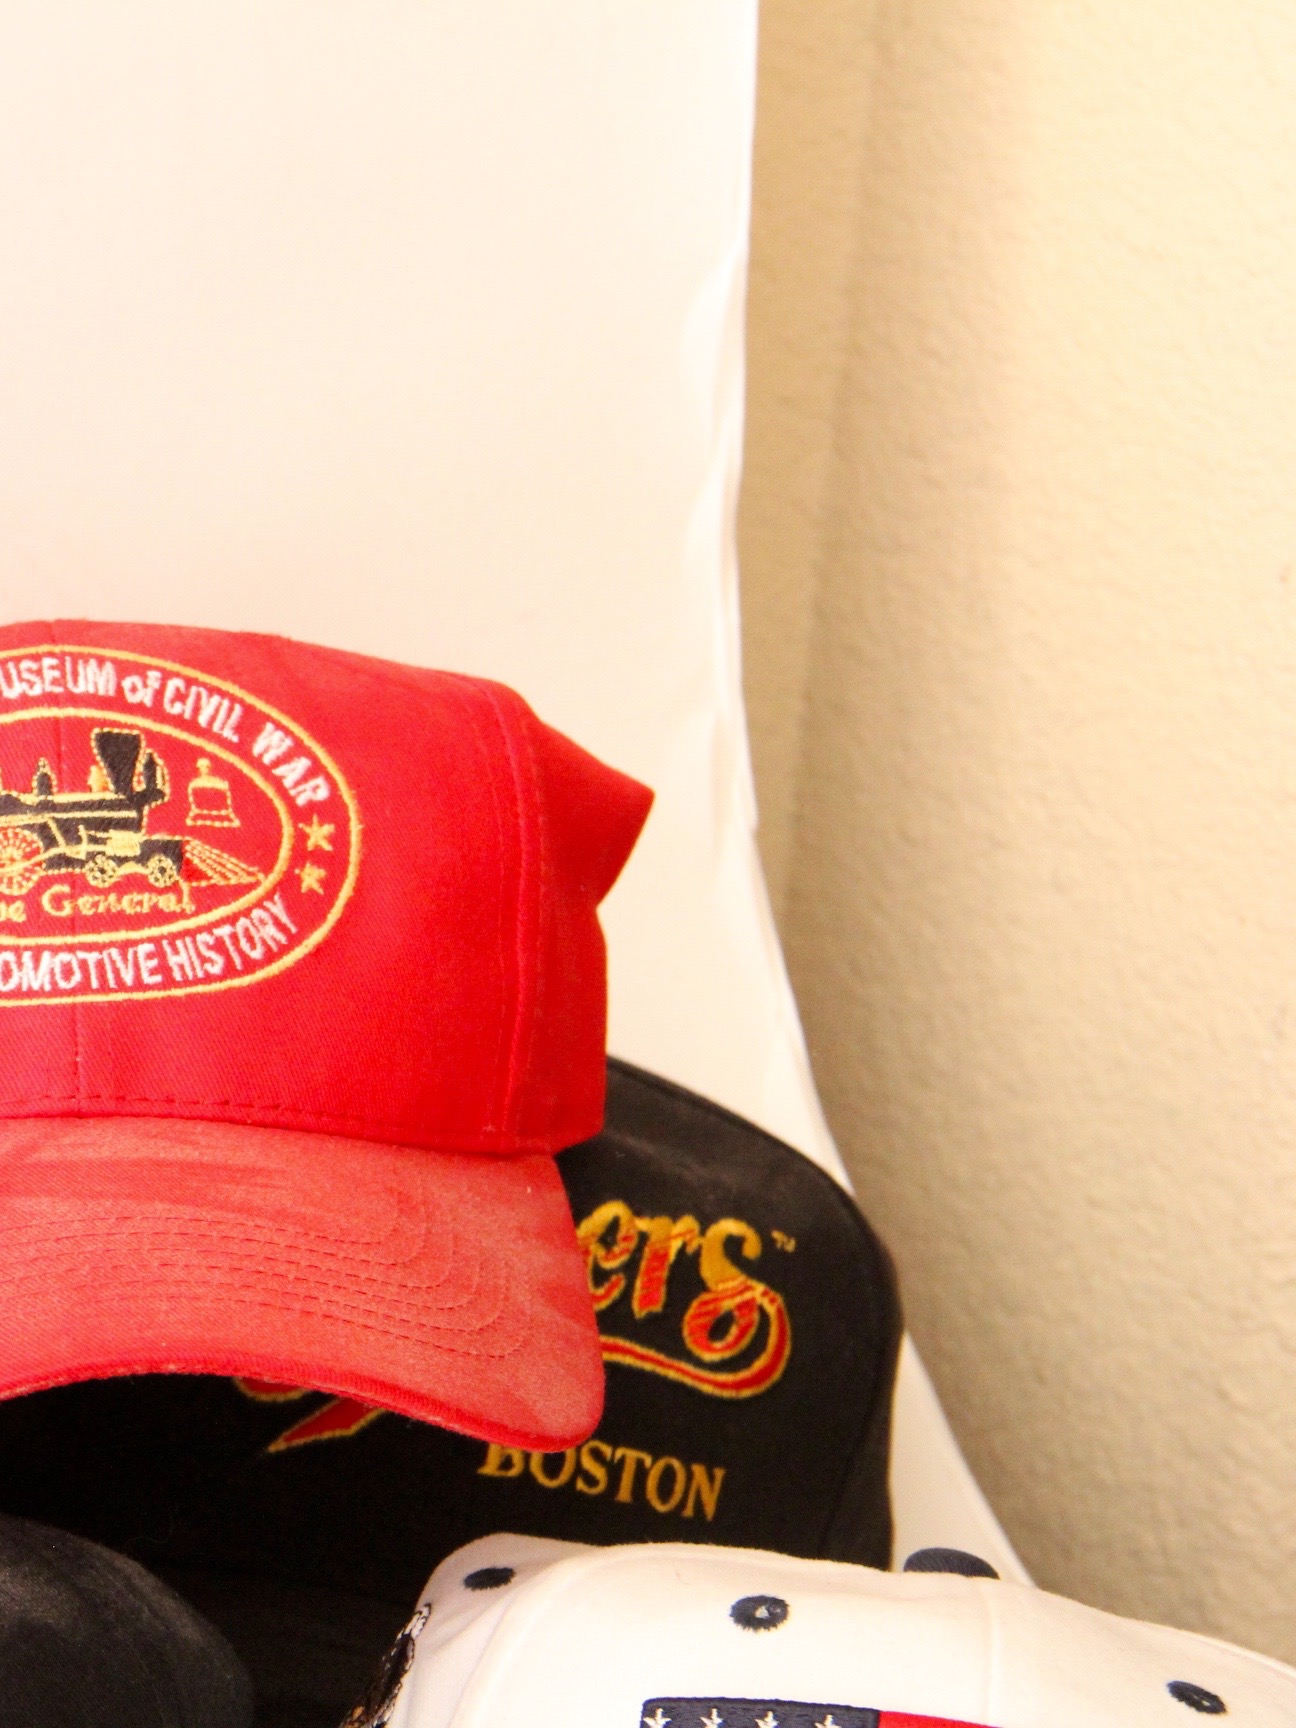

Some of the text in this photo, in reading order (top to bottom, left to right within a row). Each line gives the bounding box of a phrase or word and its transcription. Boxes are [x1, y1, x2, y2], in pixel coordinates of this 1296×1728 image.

[119, 668, 161, 701] of
[163, 678, 241, 743] CIVIL
[250, 718, 331, 807] WAR
[41, 884, 196, 916] General
[166, 894, 301, 982] HISTORY
[576, 1200, 791, 1378] ers
[477, 1439, 726, 1521] BOSTON
